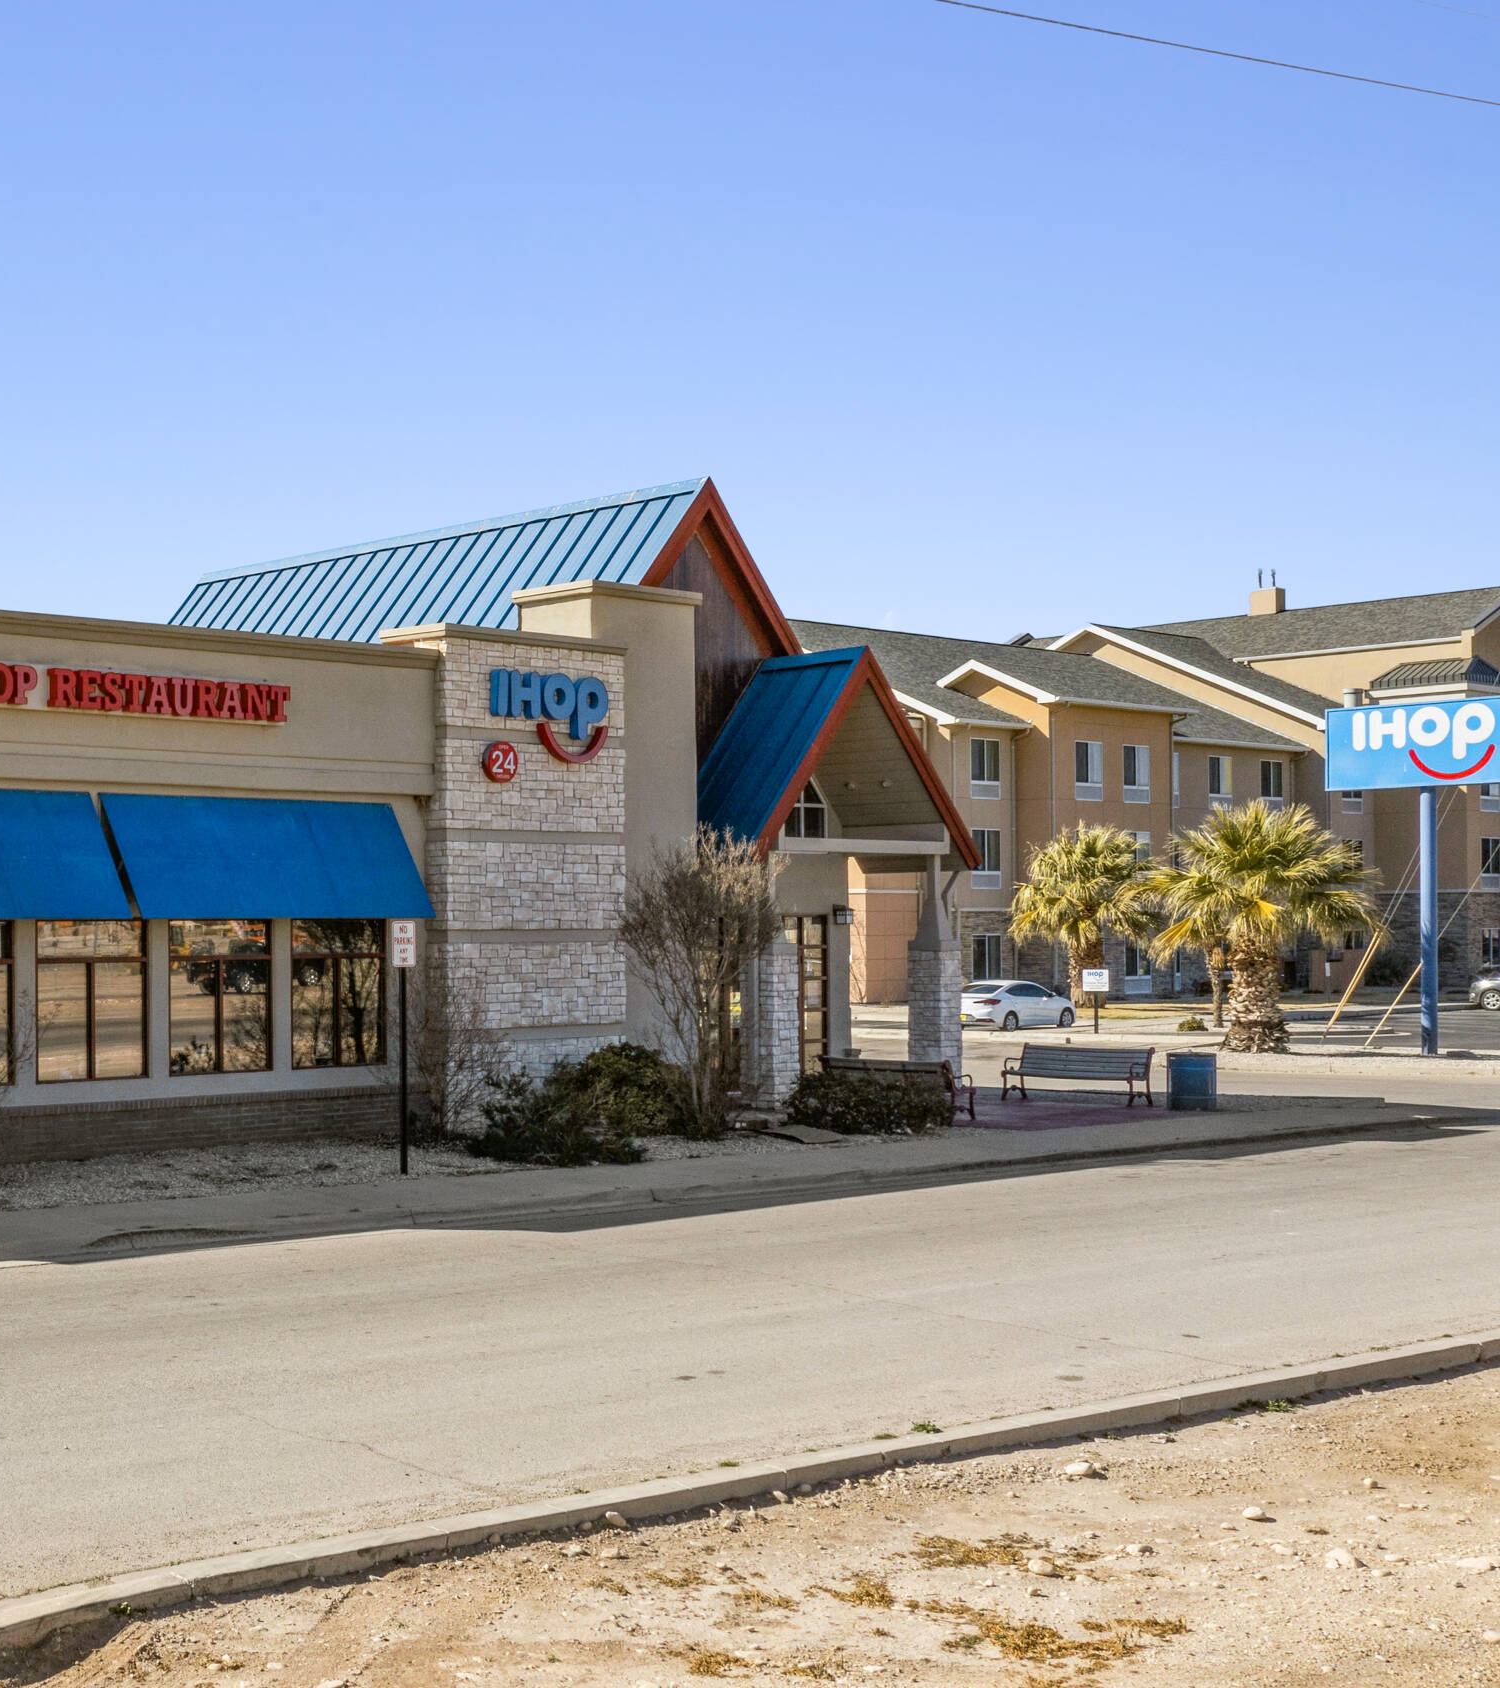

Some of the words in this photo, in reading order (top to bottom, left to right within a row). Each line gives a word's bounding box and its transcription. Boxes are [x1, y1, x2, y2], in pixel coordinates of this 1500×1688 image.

[47, 667, 291, 723] RESTAURANT
[491, 750, 516, 774] 24
[399, 925, 408, 934] NO
